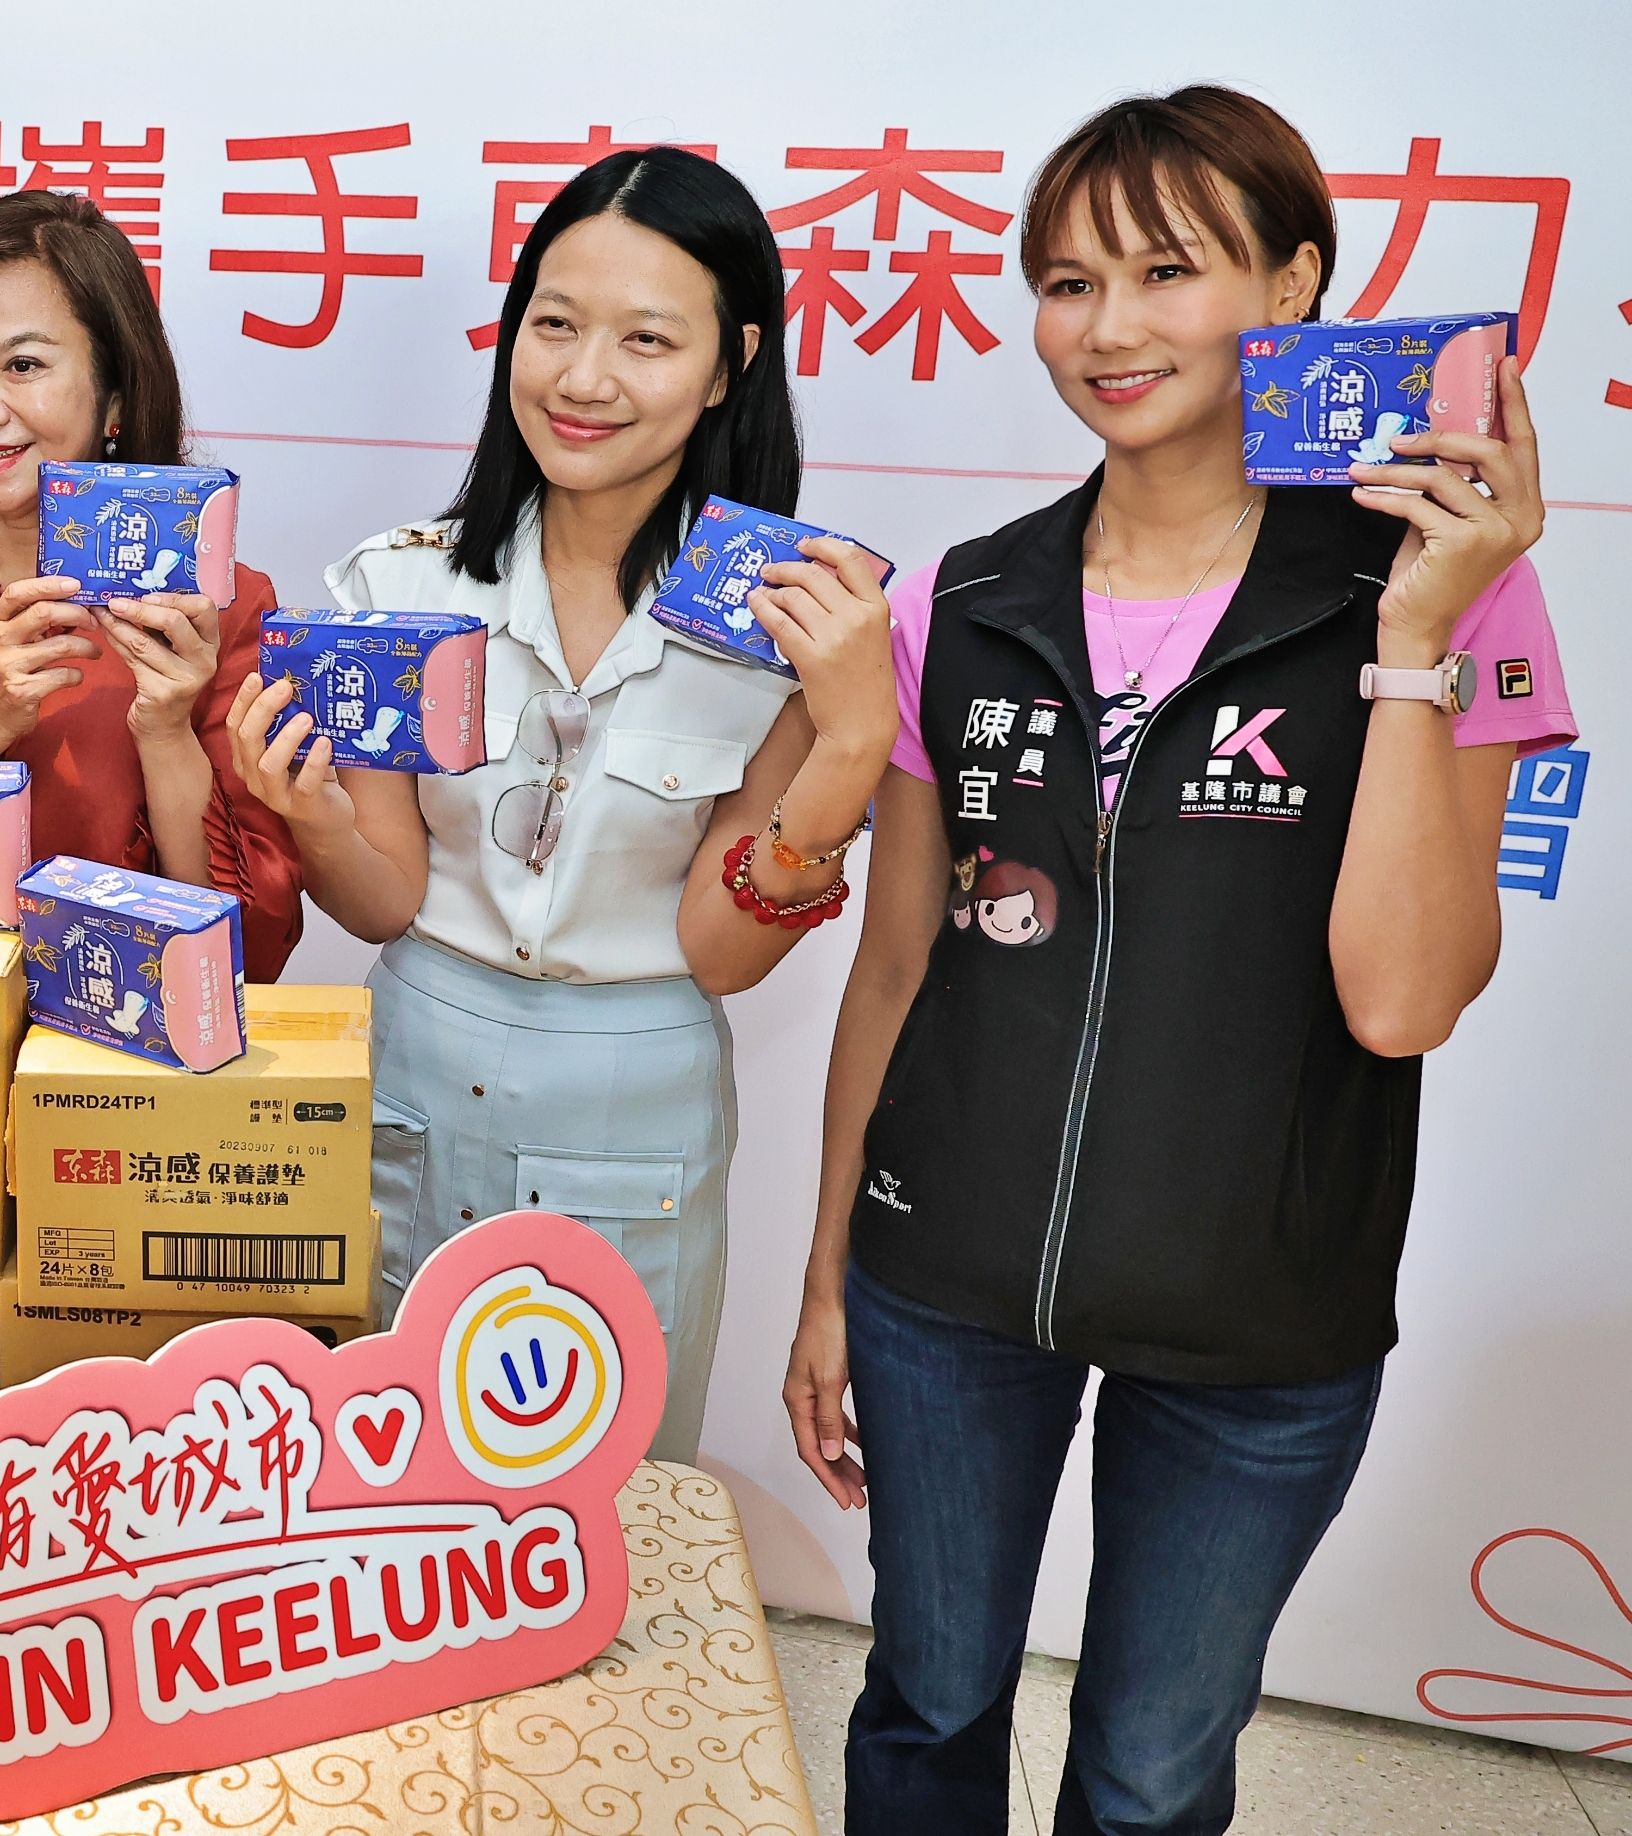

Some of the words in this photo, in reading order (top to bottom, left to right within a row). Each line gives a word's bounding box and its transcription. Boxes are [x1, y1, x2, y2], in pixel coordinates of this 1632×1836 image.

[1328, 369, 1366, 440] 涼感
[118, 512, 148, 571] 涼感
[718, 546, 767, 605] 涼感
[335, 665, 365, 730] 涼感
[957, 697, 1021, 821] 陳宜
[1015, 708, 1058, 777] 議員
[1180, 780, 1308, 806] 基隆市議會
[1180, 803, 1225, 812] KEELUNG
[1229, 804, 1254, 812] CITY
[1256, 805, 1303, 816] COUNCIL
[85, 940, 116, 1010] 涼感
[32, 1093, 156, 1111] 1PMRD24TP1
[306, 1106, 334, 1119] 15cm
[128, 1152, 201, 1185] 涼感
[208, 1163, 306, 1187] 保養護墊
[219, 1140, 276, 1153] 20230907
[287, 1145, 300, 1154] 61
[192, 1282, 206, 1291] 47
[216, 1282, 251, 1293] 10049
[259, 1285, 295, 1294] 70323
[13, 1303, 142, 1326] 1SMLS08TP2
[151, 1525, 571, 1704] KEELUNG
